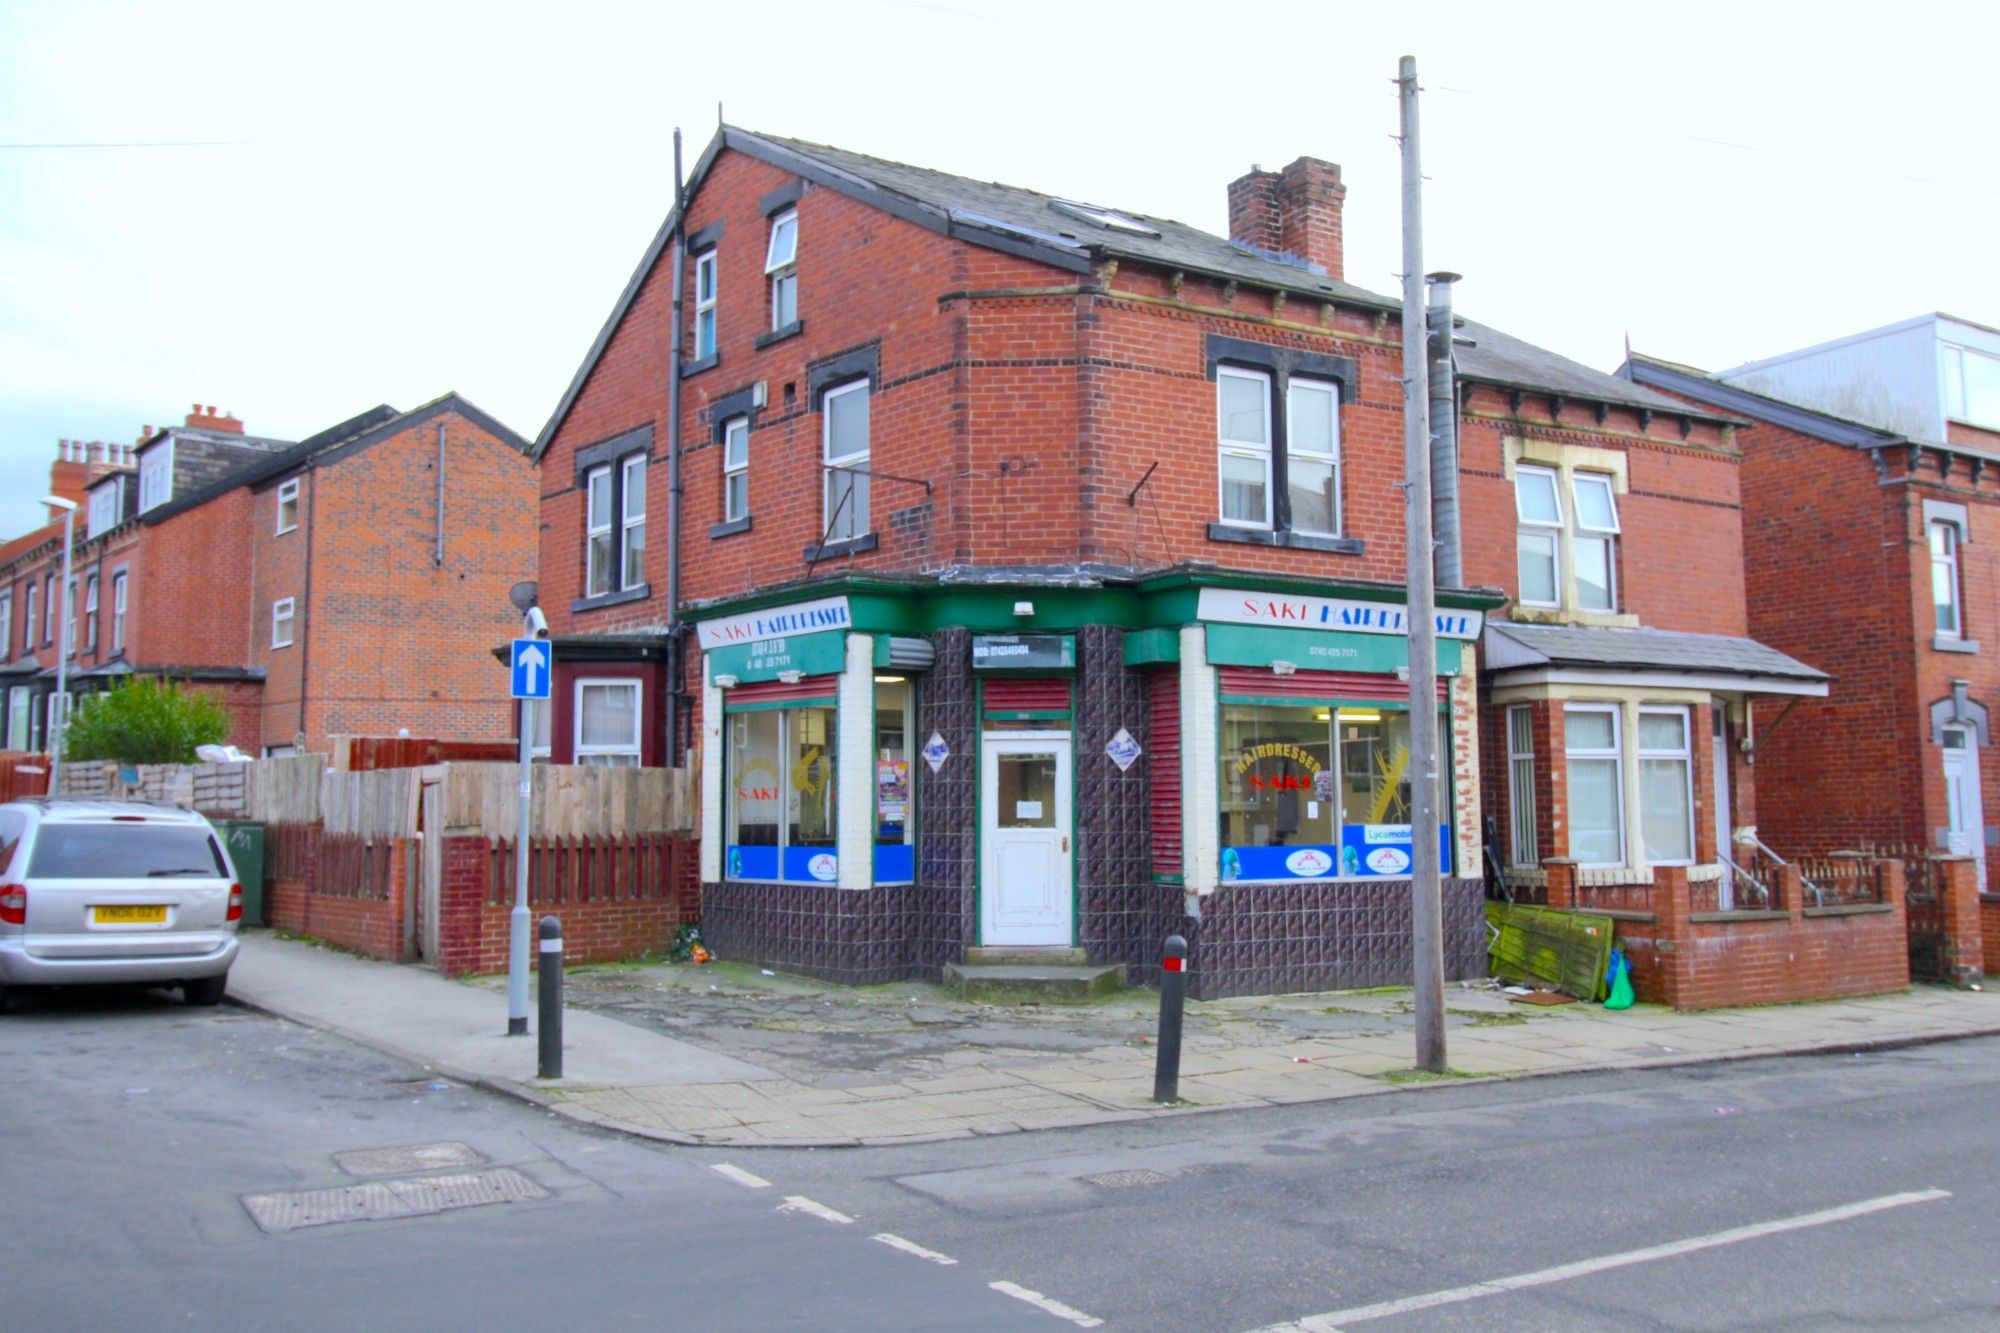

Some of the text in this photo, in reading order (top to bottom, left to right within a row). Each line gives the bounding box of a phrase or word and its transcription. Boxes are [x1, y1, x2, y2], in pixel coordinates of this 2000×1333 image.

[1243, 600, 1474, 634] SAKI HAIRDRSER
[710, 622, 753, 641] SAKI
[1341, 648, 1358, 658] 7171
[1235, 743, 1322, 774] HAIRDRESSER
[1248, 774, 1311, 790] SAKI
[738, 785, 780, 801] SAKI
